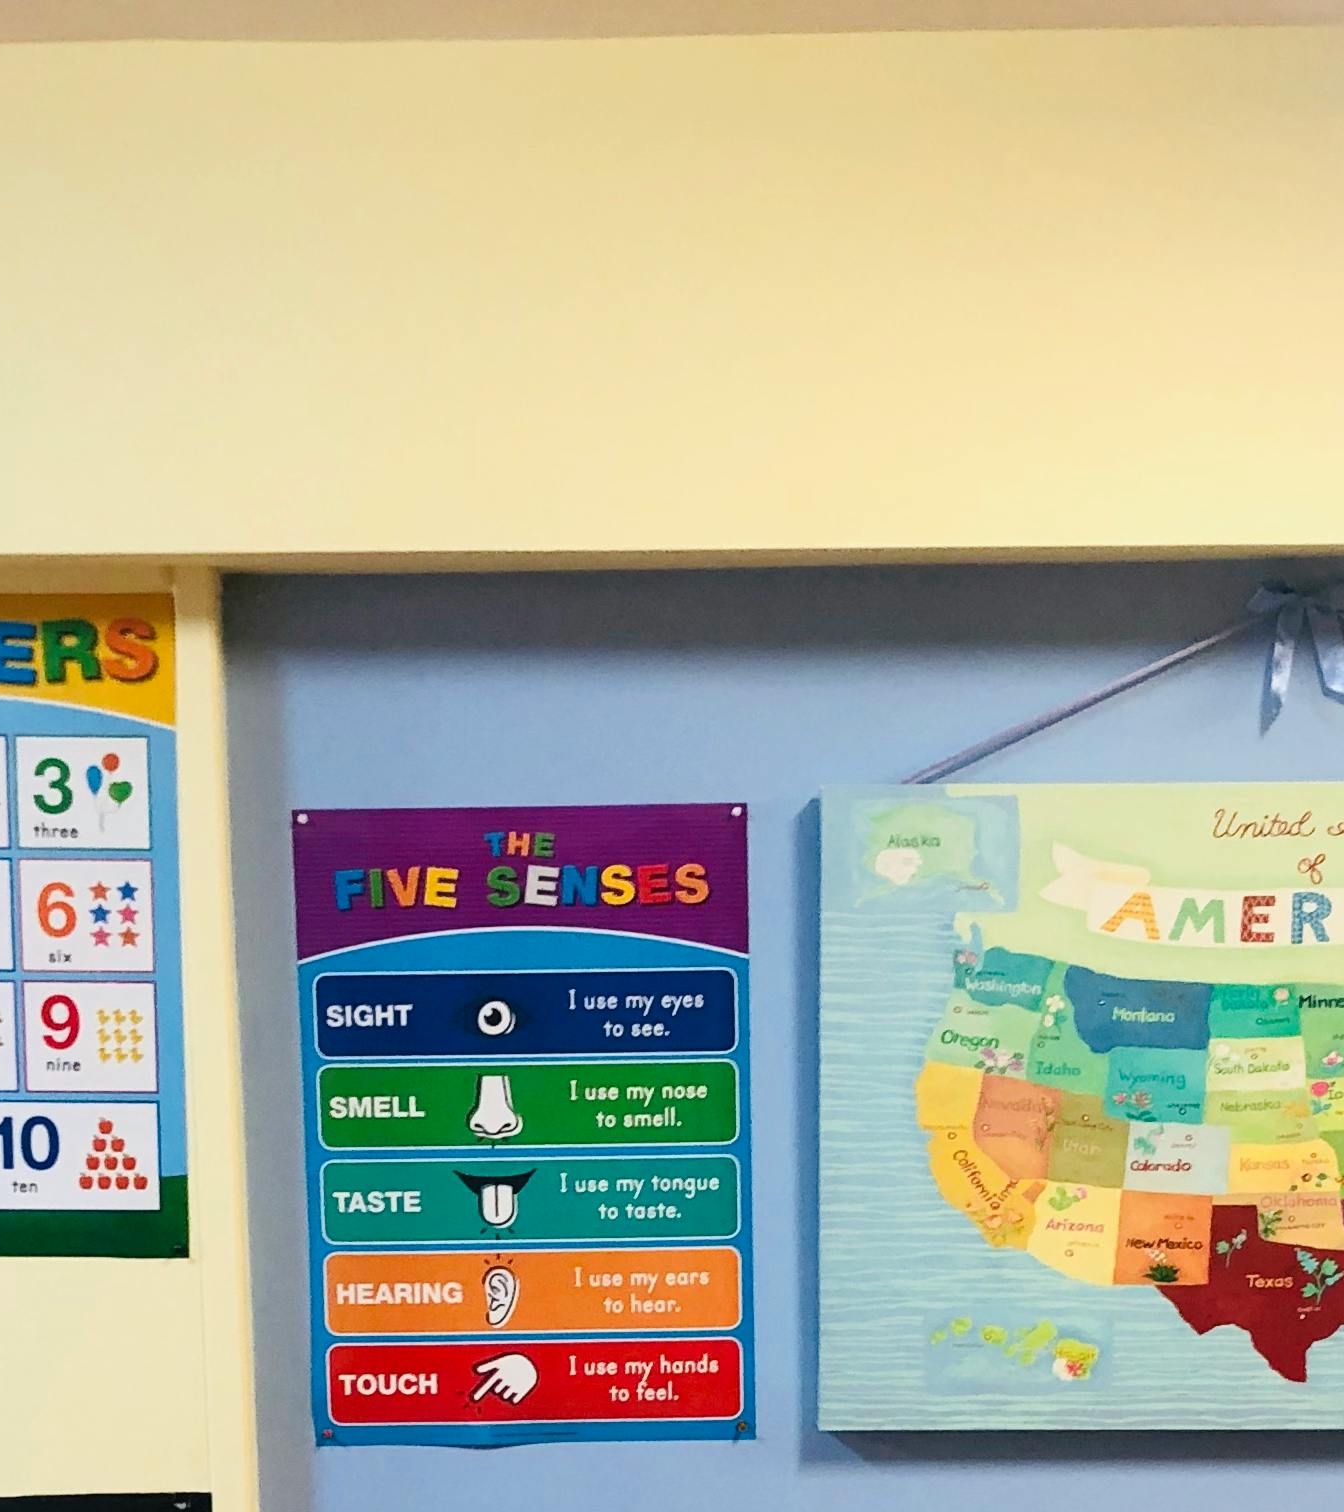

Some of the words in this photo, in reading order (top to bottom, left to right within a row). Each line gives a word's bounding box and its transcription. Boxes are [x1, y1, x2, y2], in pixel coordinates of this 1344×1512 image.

[33, 757, 73, 814] 3
[34, 824, 79, 839] three
[1212, 808, 1315, 839] United
[484, 831, 555, 857] THE
[888, 834, 940, 848] Alaska
[1296, 853, 1326, 885] of
[333, 867, 459, 910] FIVE
[486, 863, 710, 906] SENSES
[37, 881, 77, 936] 6
[48, 949, 73, 963] six
[965, 978, 1041, 997] Washington
[568, 989, 577, 1009] I
[584, 992, 617, 1010] use
[626, 991, 654, 1013] my
[662, 991, 704, 1013] eyes
[40, 993, 80, 1048] 9
[326, 1004, 413, 1027] SIGHT
[1112, 1007, 1175, 1023] Montana
[603, 1020, 625, 1037] to
[631, 1021, 670, 1037] see.
[941, 1030, 999, 1050] Oregon
[46, 1058, 80, 1071] nine
[1036, 1062, 1081, 1075] Idaho
[1214, 1063, 1244, 1075] South
[1248, 1062, 1289, 1074] Dakota
[1119, 1070, 1186, 1089] Wyoming
[569, 1081, 578, 1100] I
[585, 1083, 619, 1100] use
[626, 1083, 655, 1106] my
[663, 1082, 707, 1099] nose
[329, 1096, 425, 1118] SMELL
[1221, 1100, 1281, 1112] Nebraska
[596, 1112, 617, 1129] to
[624, 1108, 682, 1128] smell.
[1130, 1159, 1192, 1171] Colorado
[1240, 1158, 1290, 1172] Kansas
[12, 1179, 38, 1192] ten
[559, 1174, 569, 1193] I
[575, 1176, 608, 1193] use
[615, 1177, 644, 1198] my
[652, 1175, 719, 1197] tongue
[333, 1191, 421, 1213] TASTE
[599, 1203, 619, 1219] to
[626, 1202, 681, 1219] taste.
[1046, 1219, 1104, 1233] Arizona
[1126, 1238, 1156, 1249] New
[1157, 1239, 1203, 1250] Mexico
[574, 1268, 583, 1287] I
[589, 1270, 622, 1287] use
[630, 1270, 658, 1292] my
[665, 1269, 709, 1285] ears
[1246, 1274, 1294, 1288] Texas
[336, 1282, 463, 1305] HEARING
[604, 1296, 624, 1313] to
[630, 1295, 681, 1313] hear.
[569, 1357, 578, 1376] I
[585, 1359, 618, 1375] use
[626, 1359, 654, 1380] my
[660, 1356, 719, 1375] hands
[339, 1374, 438, 1396] TOUCH
[609, 1384, 629, 1401] to
[636, 1382, 679, 1402] feel.
